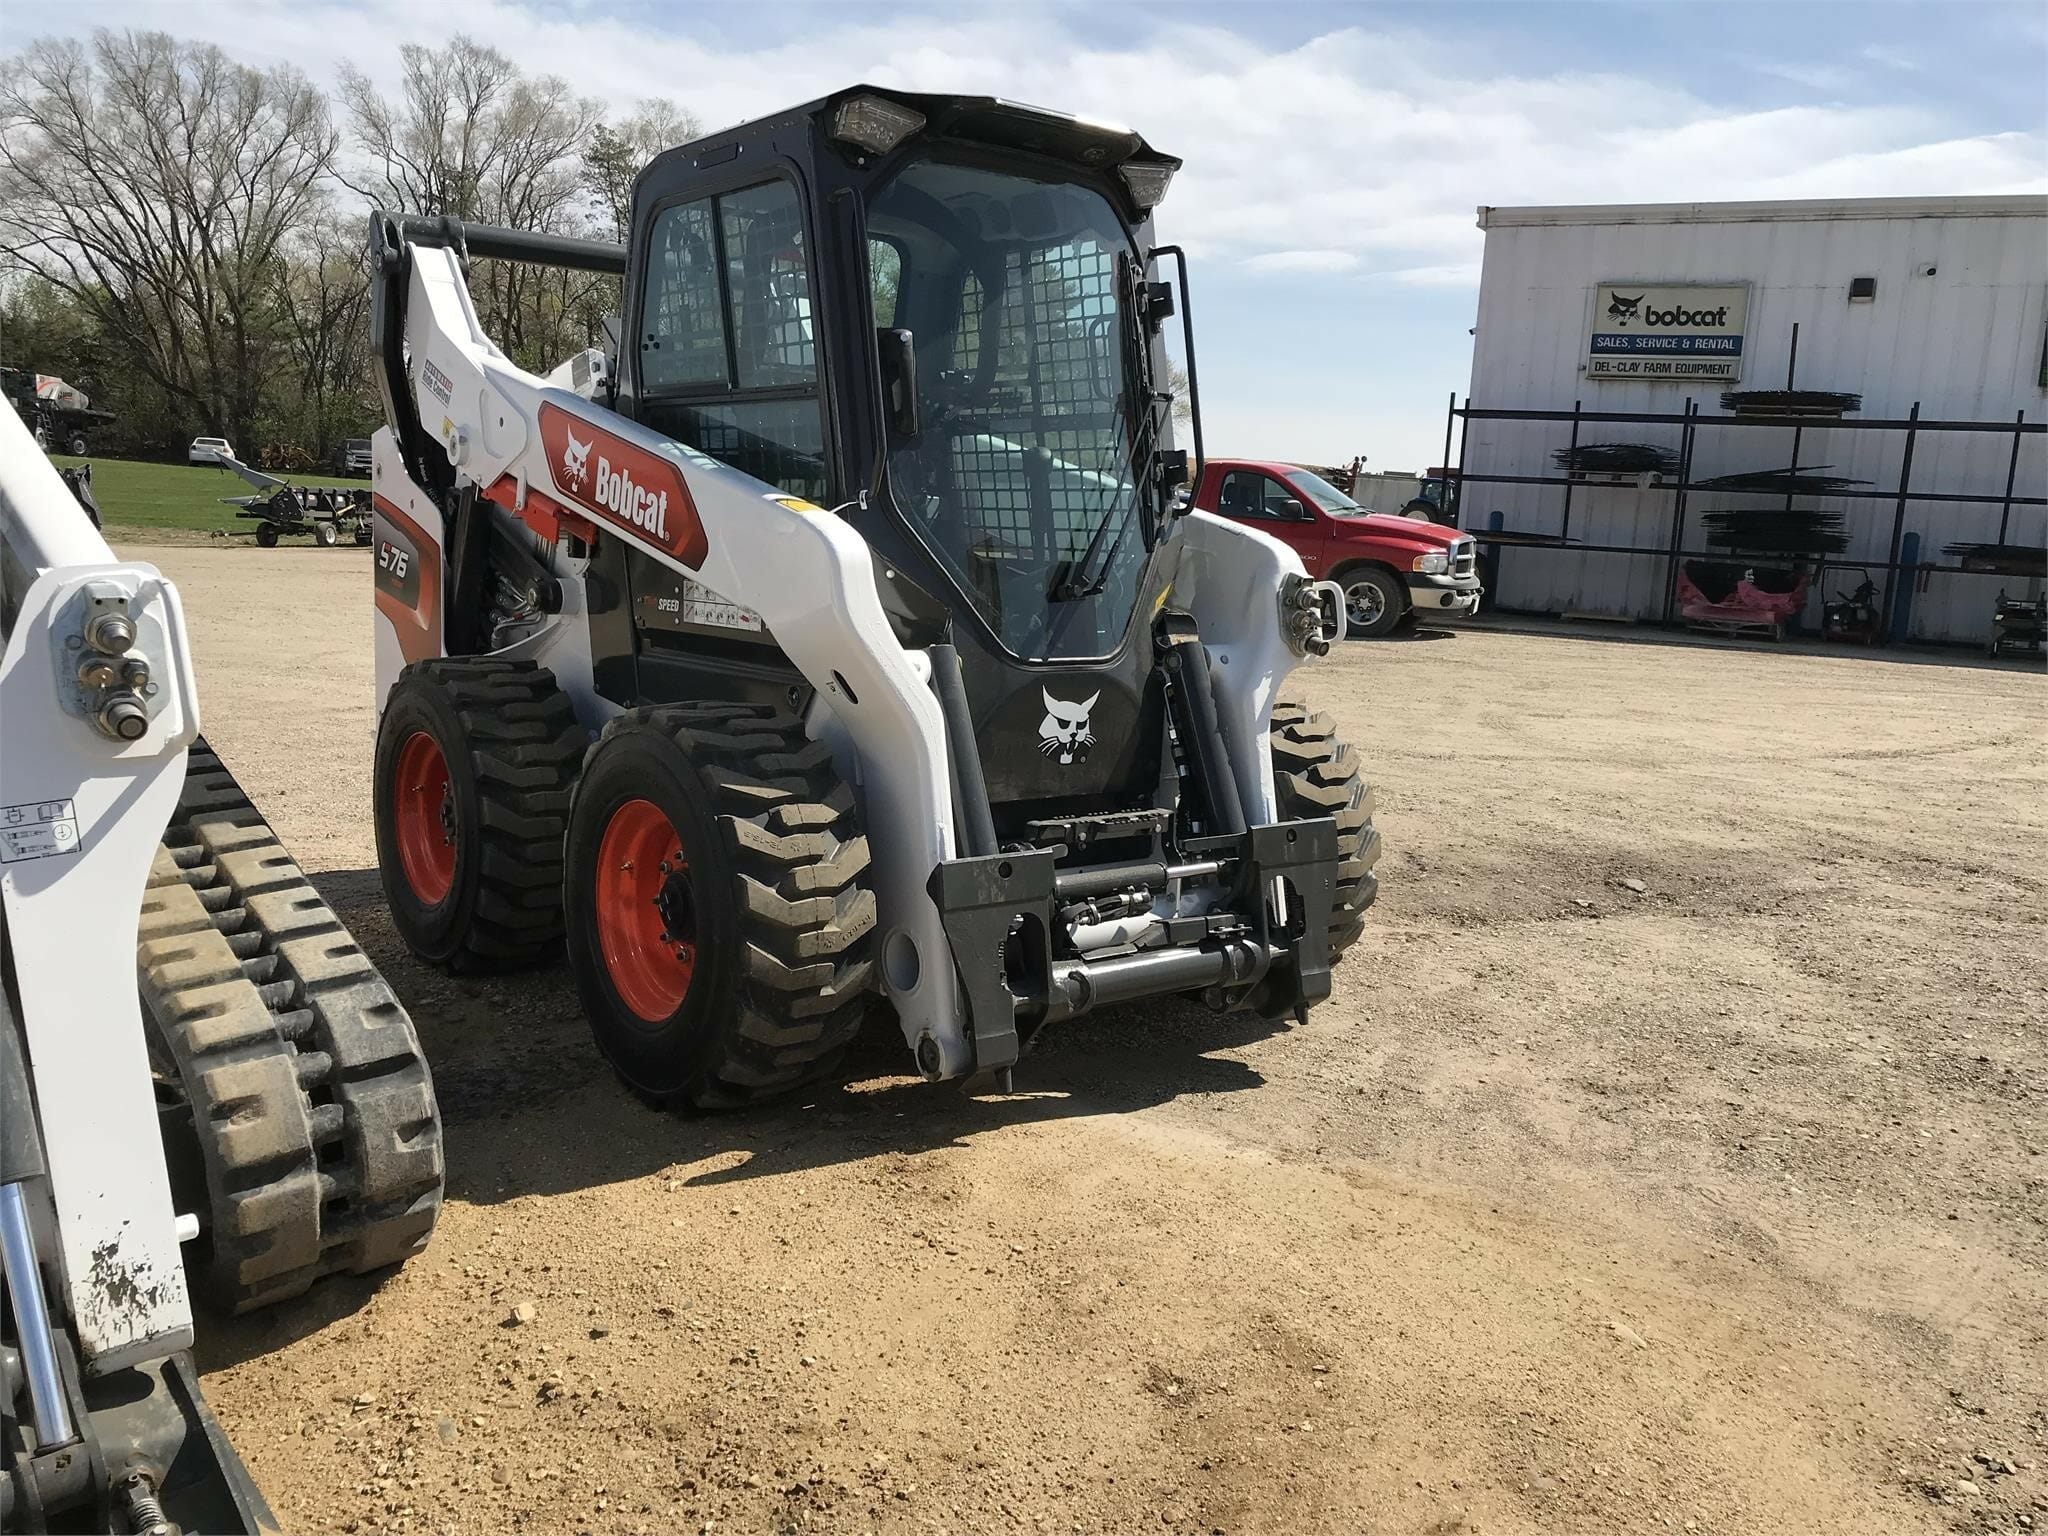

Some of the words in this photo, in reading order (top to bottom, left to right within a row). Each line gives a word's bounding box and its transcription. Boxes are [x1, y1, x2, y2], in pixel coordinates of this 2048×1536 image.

[1645, 305, 1727, 327] bobcat
[1597, 337, 1631, 349] SALES,
[1636, 338, 1678, 349] SERVICE
[1682, 339, 1690, 349] &
[1695, 339, 1736, 350] RENTAL
[1594, 361, 1640, 373] DEL-CLAY
[1643, 362, 1672, 374] FARM
[1675, 363, 1732, 375] EQUIPMENT
[595, 455, 668, 540] Bobcat
[379, 541, 409, 578] S76
[658, 598, 680, 612] SPEED
